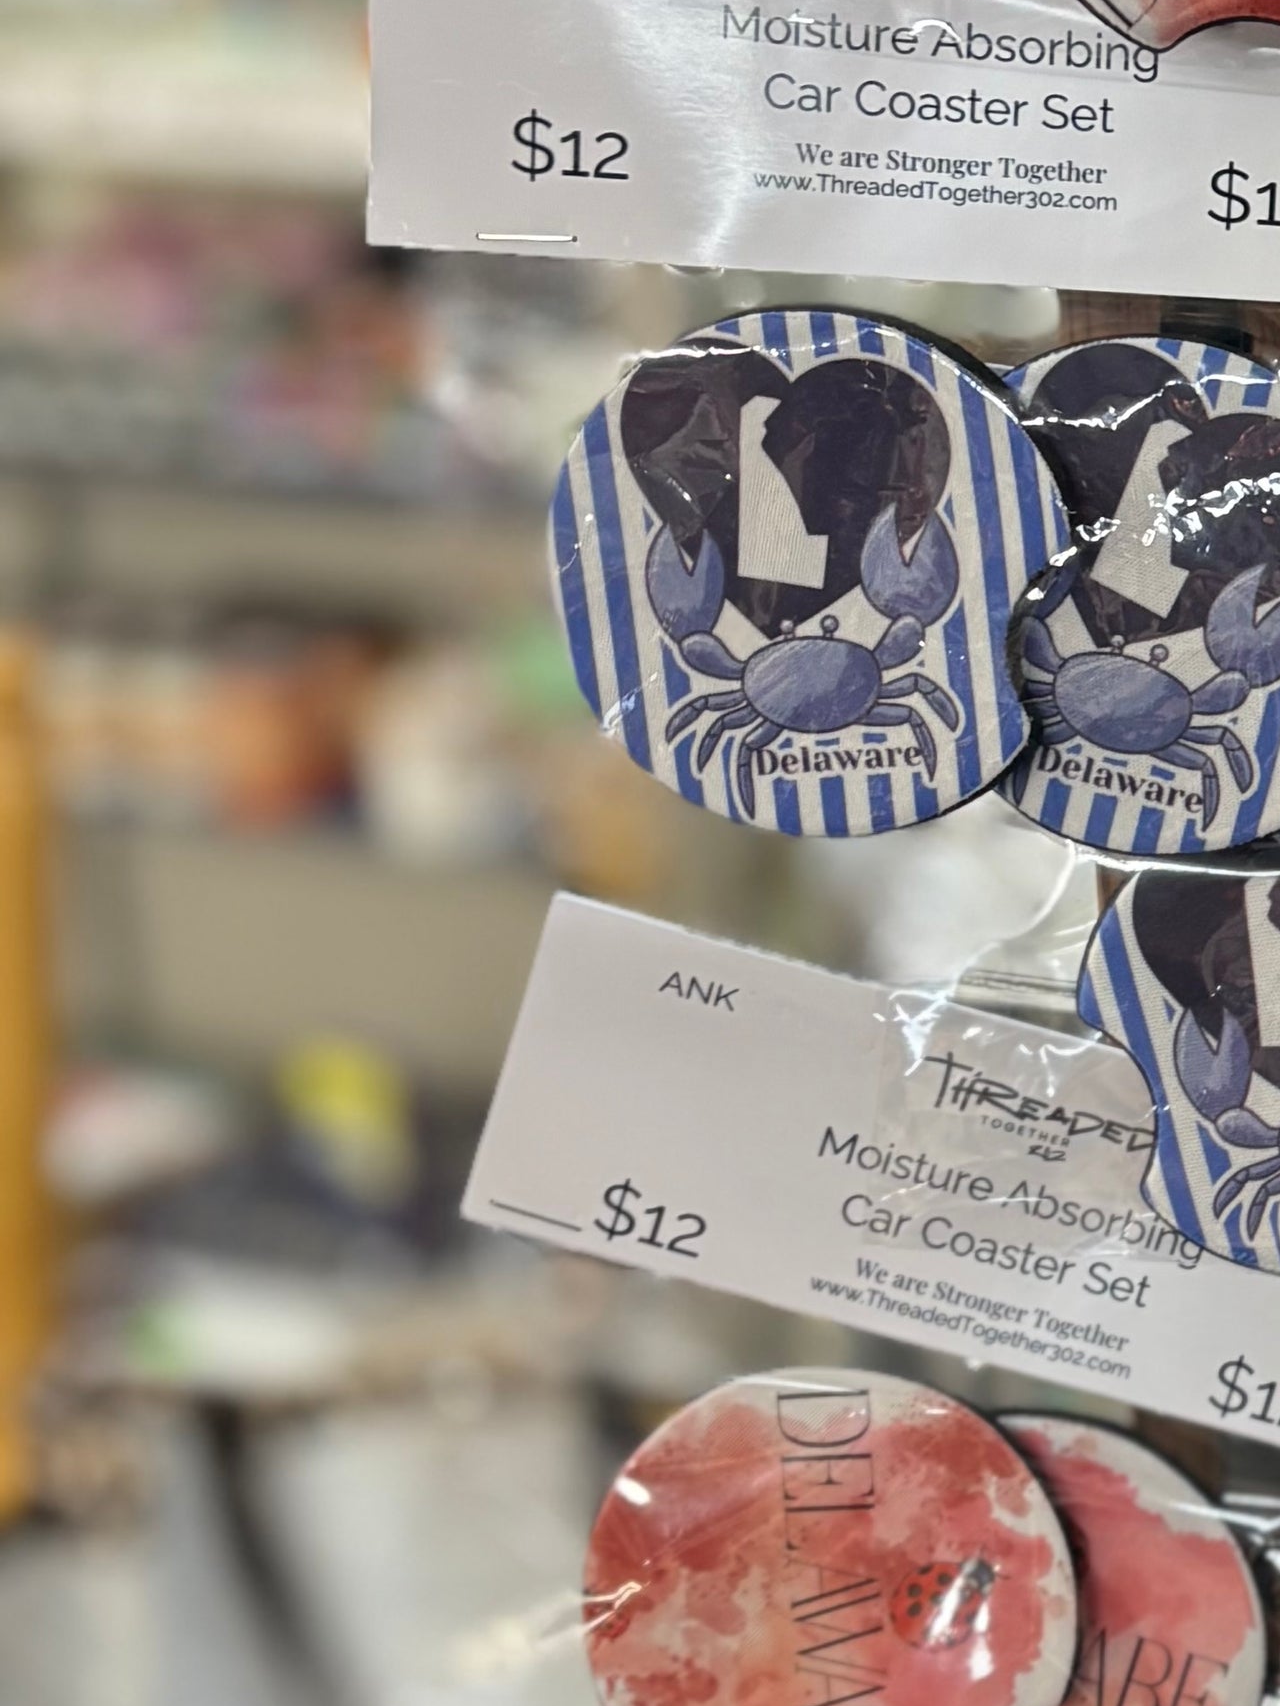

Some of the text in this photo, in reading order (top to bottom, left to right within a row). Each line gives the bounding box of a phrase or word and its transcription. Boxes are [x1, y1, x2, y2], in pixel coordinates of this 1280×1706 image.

[722, 4, 1160, 83] Moisture Absorbing
[764, 73, 1115, 134] Car Coaster Set
[511, 109, 630, 182] $12
[795, 142, 1108, 190] We are Stronger Together
[753, 170, 1118, 212] www.ThreadedTogether302.com
[754, 741, 923, 778] Delaware
[1035, 742, 1204, 816] Delaware
[659, 969, 740, 1013] ANK
[979, 1114, 1071, 1147] TOGETHER
[593, 1177, 707, 1258] $12
[816, 1126, 1202, 1270] Moisture Absorbing
[840, 1194, 1152, 1309] Car Coaster Set
[809, 1274, 1132, 1380] www.ThreadedTogether302.com
[855, 1256, 1131, 1353] We are Stronger Together
